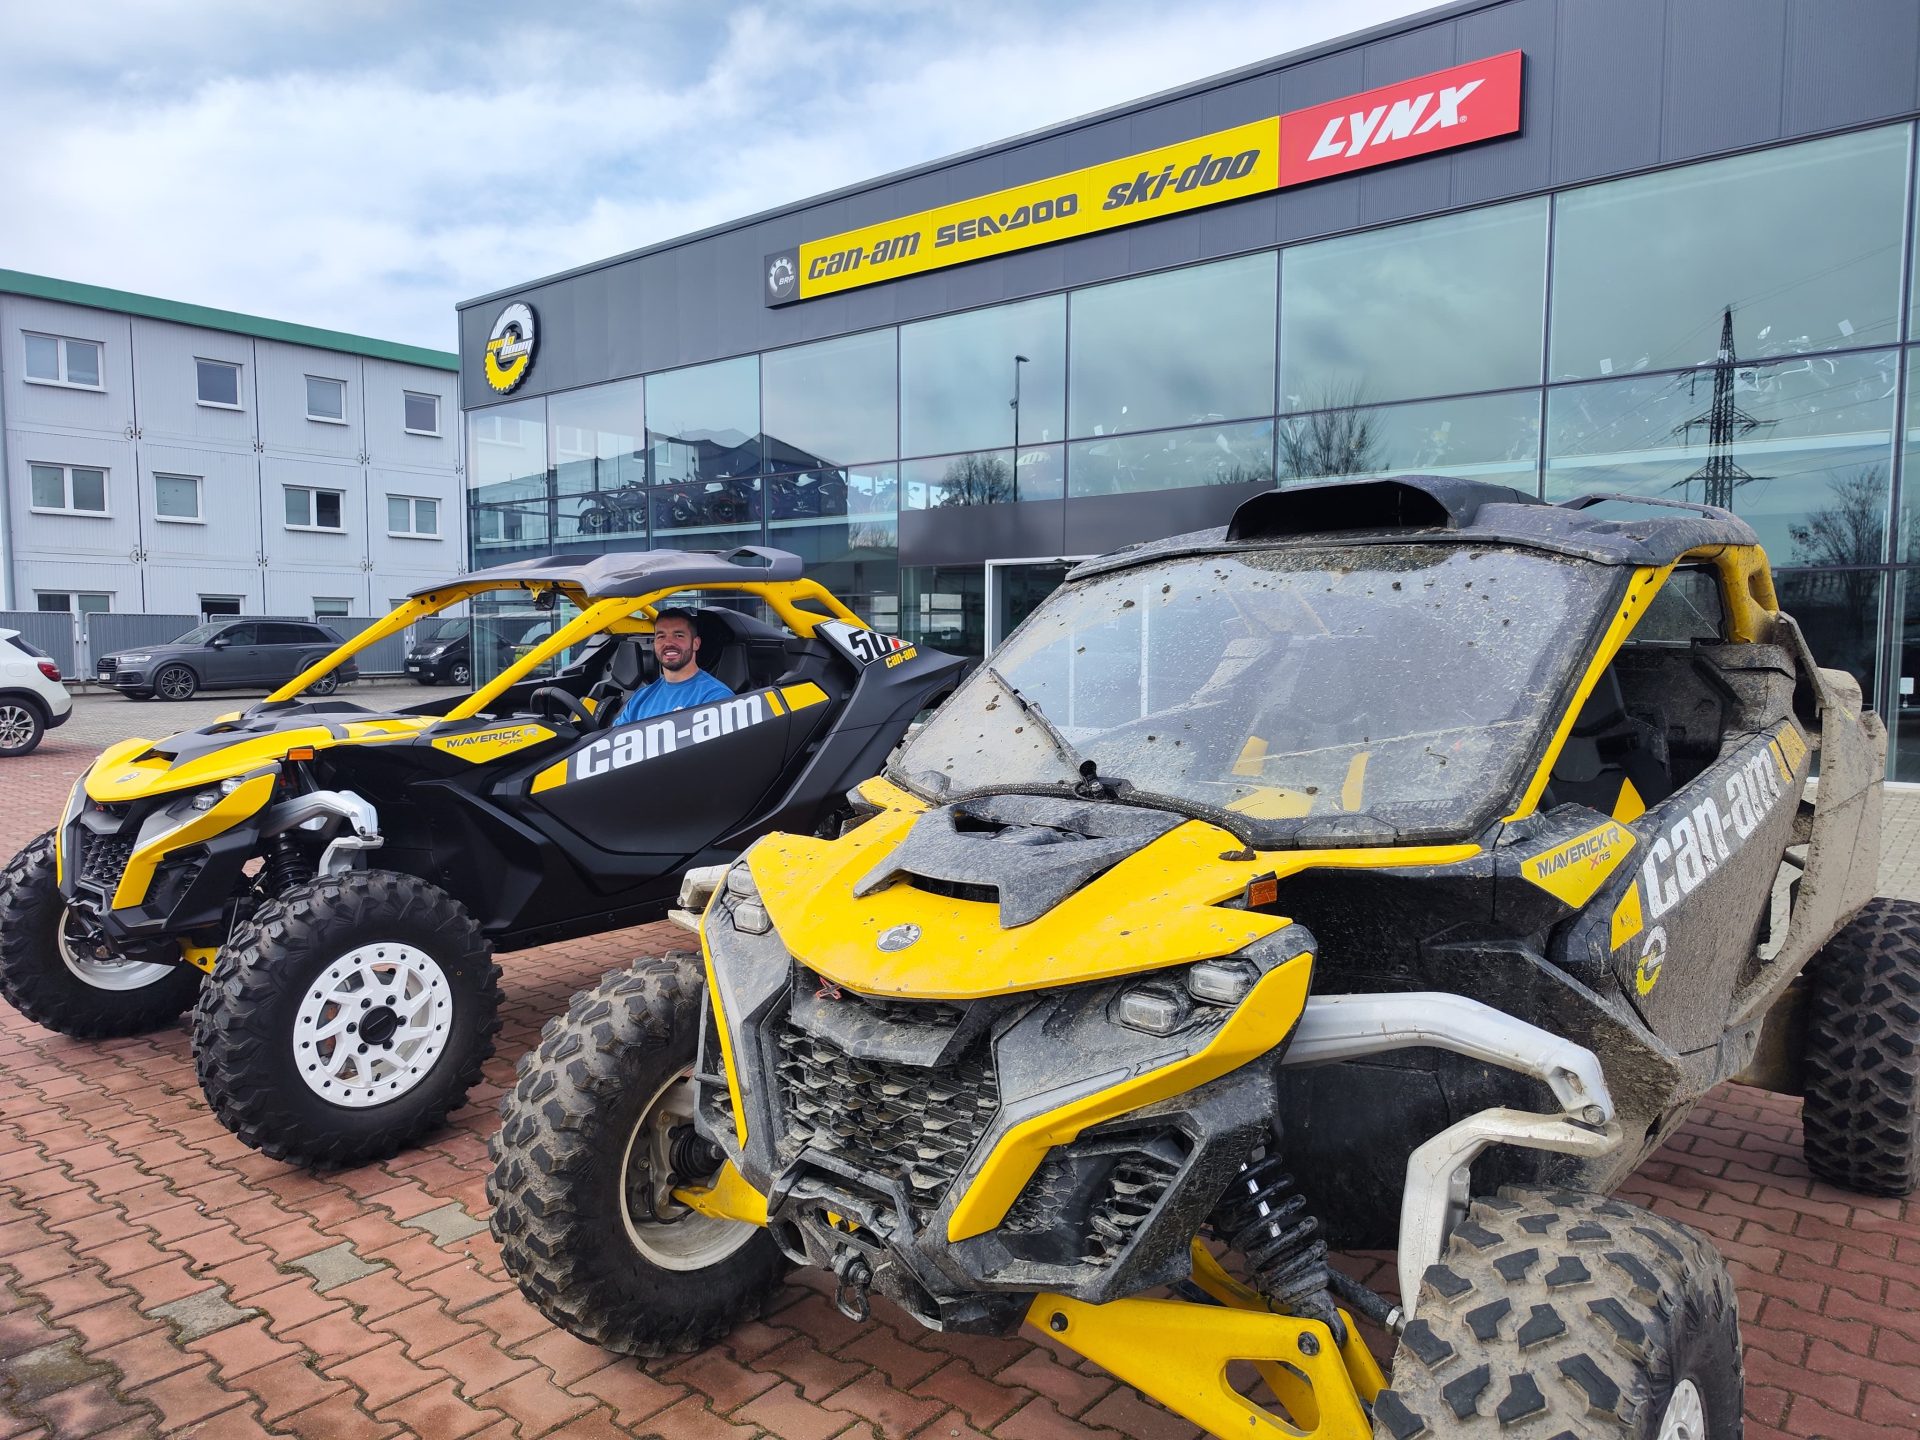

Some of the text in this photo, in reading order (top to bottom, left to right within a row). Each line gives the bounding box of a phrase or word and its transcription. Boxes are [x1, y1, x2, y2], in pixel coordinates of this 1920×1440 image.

[1307, 79, 1486, 161] LYNX
[1102, 150, 1260, 210] ski-doo
[808, 232, 920, 280] can-am
[779, 275, 794, 286] BRP
[885, 647, 917, 669] can-am
[446, 730, 520, 748] MAVERICK
[576, 694, 763, 780] can-am
[1536, 832, 1608, 879] MAVERICK
[1643, 748, 1781, 919] can-am
